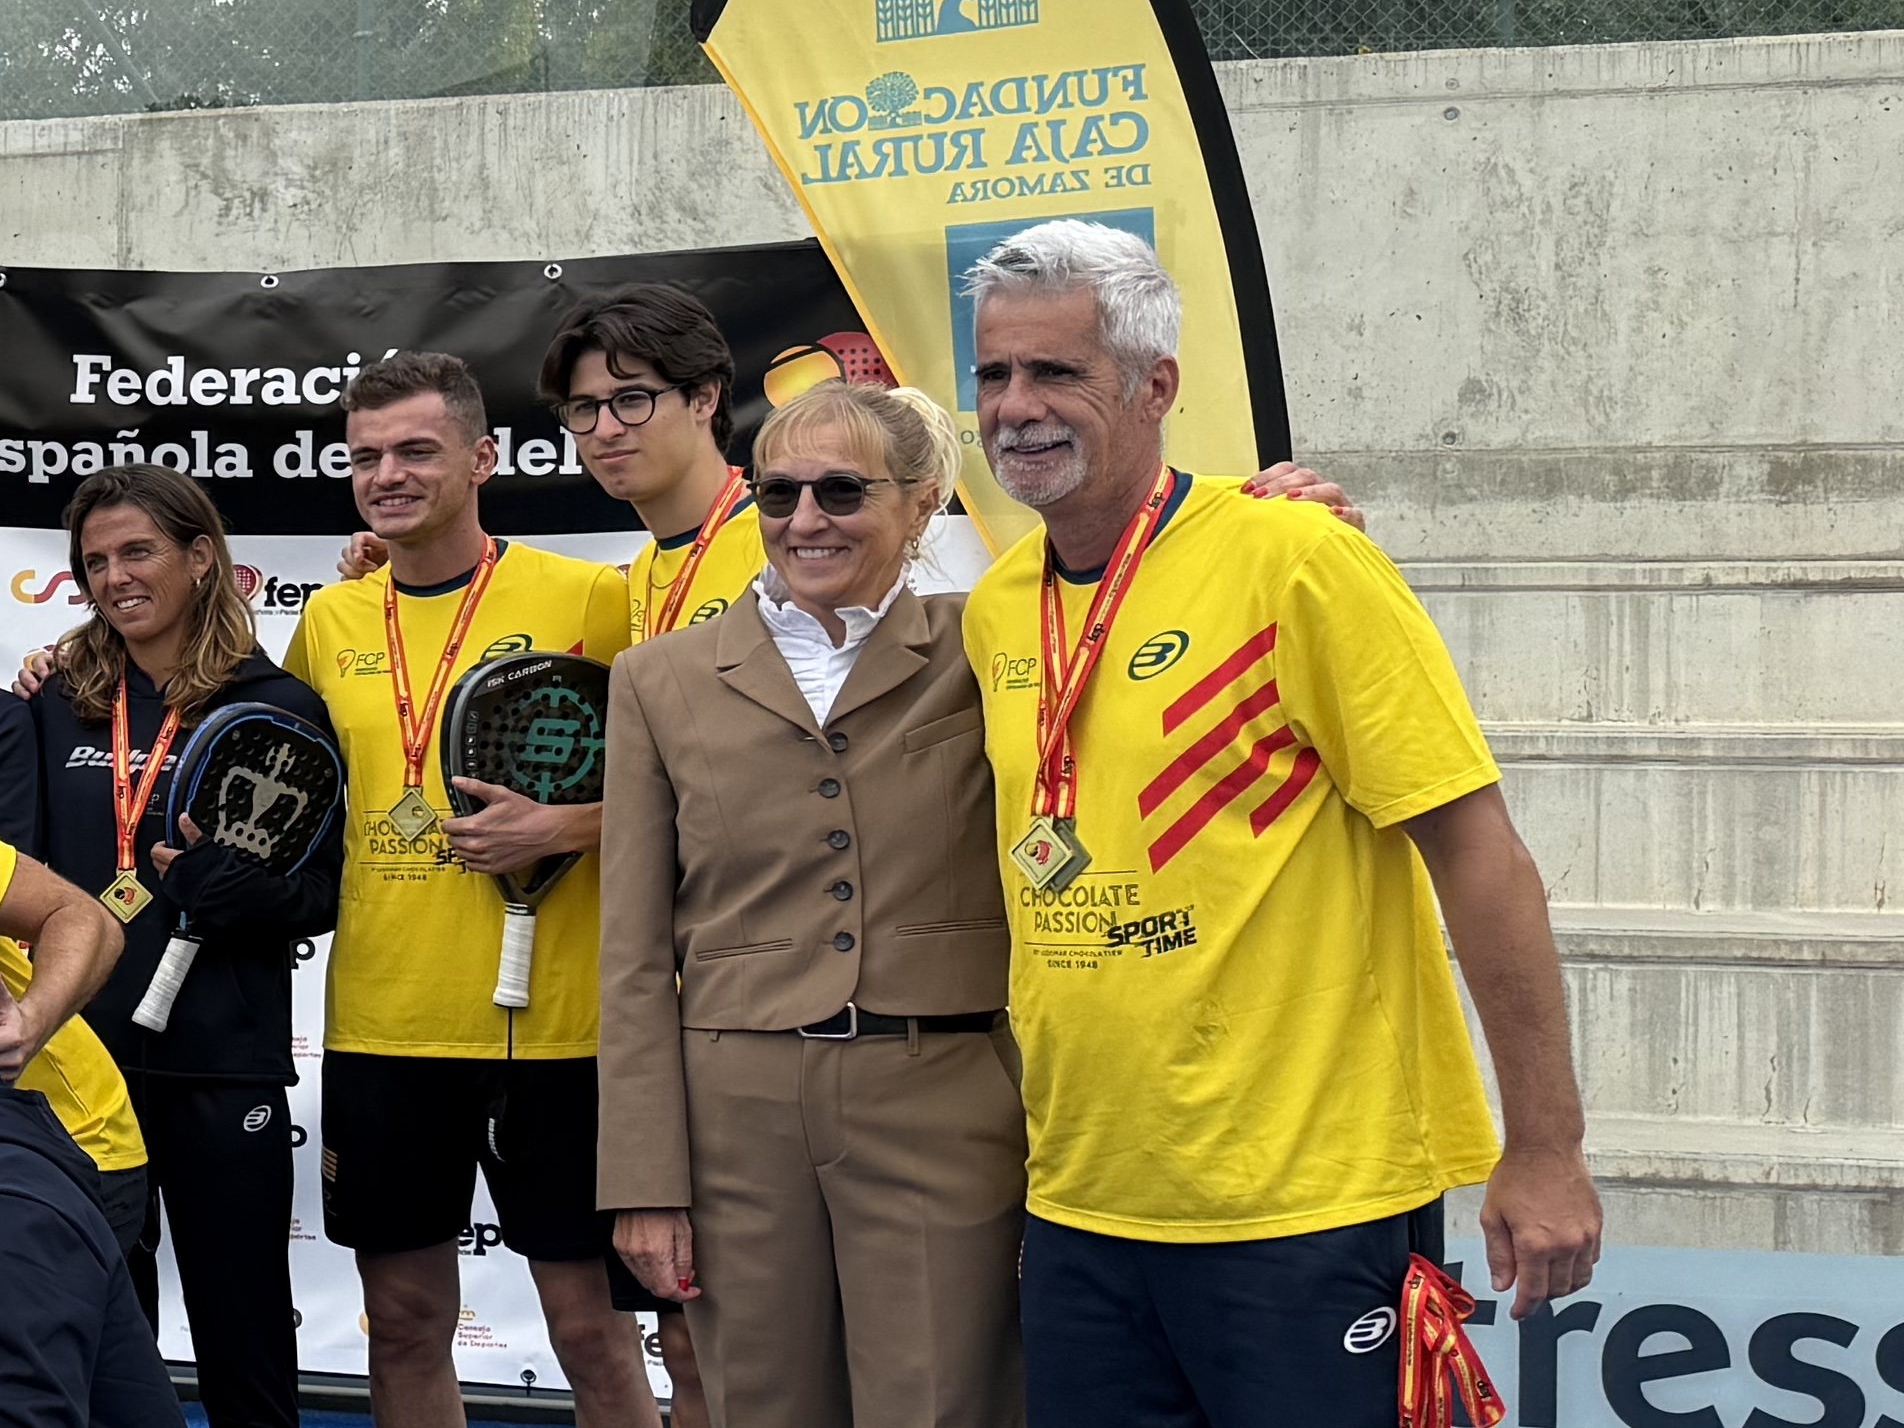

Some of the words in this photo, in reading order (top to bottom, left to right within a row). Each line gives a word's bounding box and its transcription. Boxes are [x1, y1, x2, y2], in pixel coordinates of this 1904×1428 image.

[70, 349, 397, 406] Federaci
[273, 430, 350, 479] de
[490, 430, 581, 476] del
[355, 651, 385, 666] FCP
[1008, 658, 1037, 676] FCP
[1020, 884, 1140, 907] CHOCOLATE
[1034, 911, 1117, 933] PASSION
[1101, 904, 1195, 947] SPORT
[1141, 927, 1198, 958] TIME
[1075, 960, 1098, 969] 1948
[458, 1222, 503, 1256] ep
